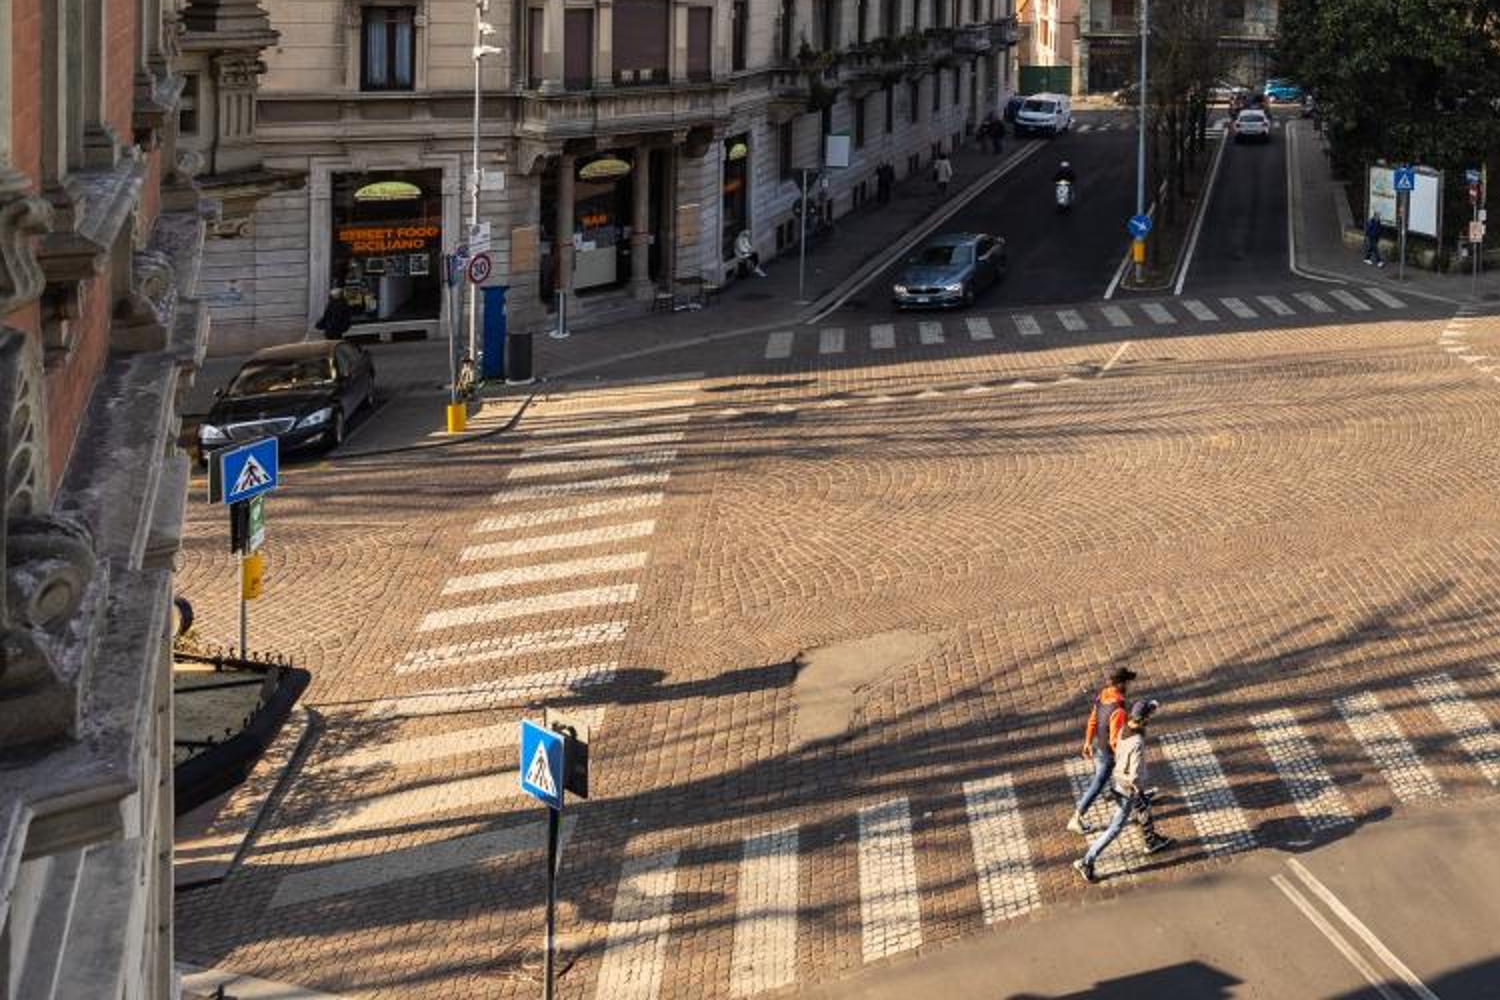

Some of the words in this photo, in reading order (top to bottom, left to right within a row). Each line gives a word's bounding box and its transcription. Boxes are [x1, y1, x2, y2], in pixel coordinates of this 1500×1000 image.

[339, 228, 393, 242] STREET
[397, 226, 438, 239] FOOD
[352, 239, 425, 251] SICILIANO
